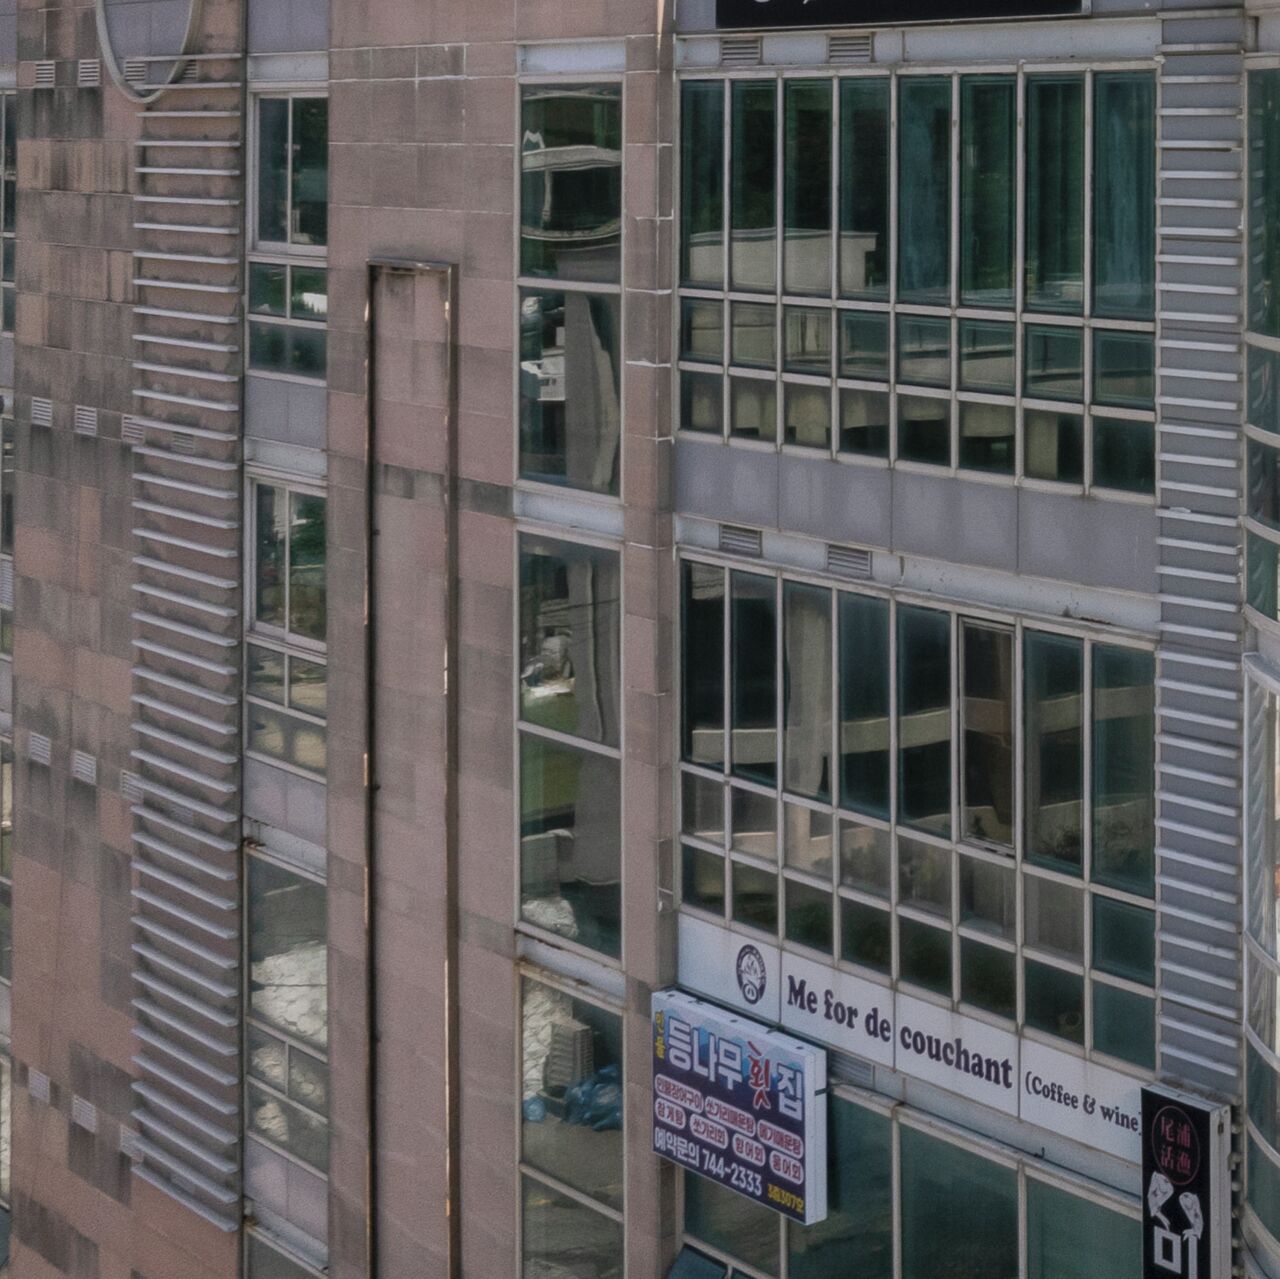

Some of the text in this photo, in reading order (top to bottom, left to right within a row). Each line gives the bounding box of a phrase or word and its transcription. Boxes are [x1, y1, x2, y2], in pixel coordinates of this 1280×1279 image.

[786, 974, 818, 1015] Me
[823, 989, 859, 1029] for
[864, 1007, 892, 1043] de
[899, 1024, 1014, 1090] couchant
[1025, 1070, 1079, 1110] (Coffee
[1082, 1093, 1096, 1115] &
[1100, 1104, 1142, 1137] wine
[655, 1126, 763, 1196] 예약문의 744-2333
